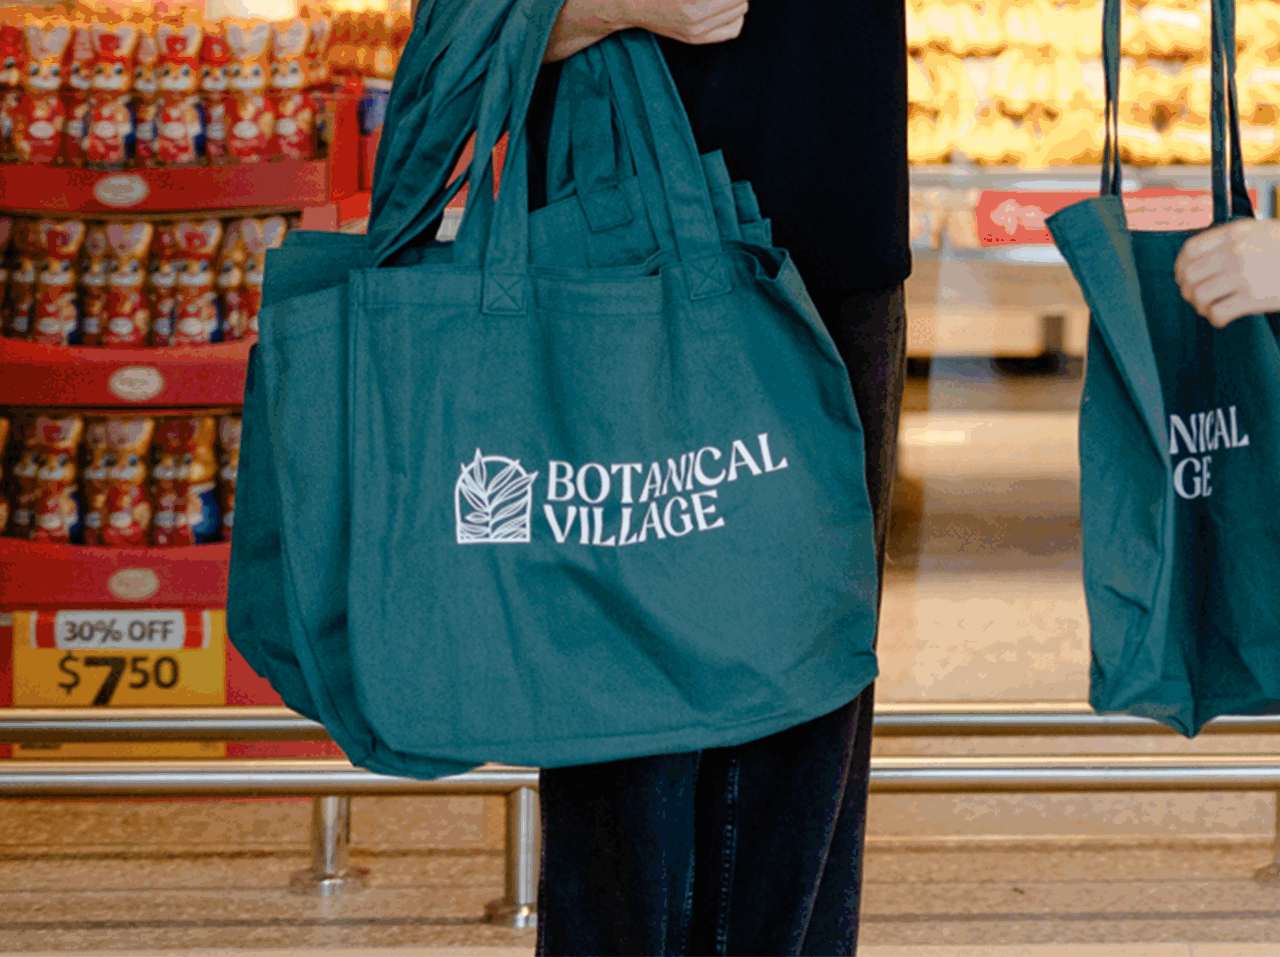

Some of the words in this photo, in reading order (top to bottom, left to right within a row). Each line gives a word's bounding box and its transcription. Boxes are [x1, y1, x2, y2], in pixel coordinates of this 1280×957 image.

[1169, 405, 1249, 454] NICAL
[548, 432, 789, 504] BOTANICAL
[543, 489, 725, 546] VILLAGE
[63, 618, 122, 643] 30%
[128, 619, 176, 642] OFF
